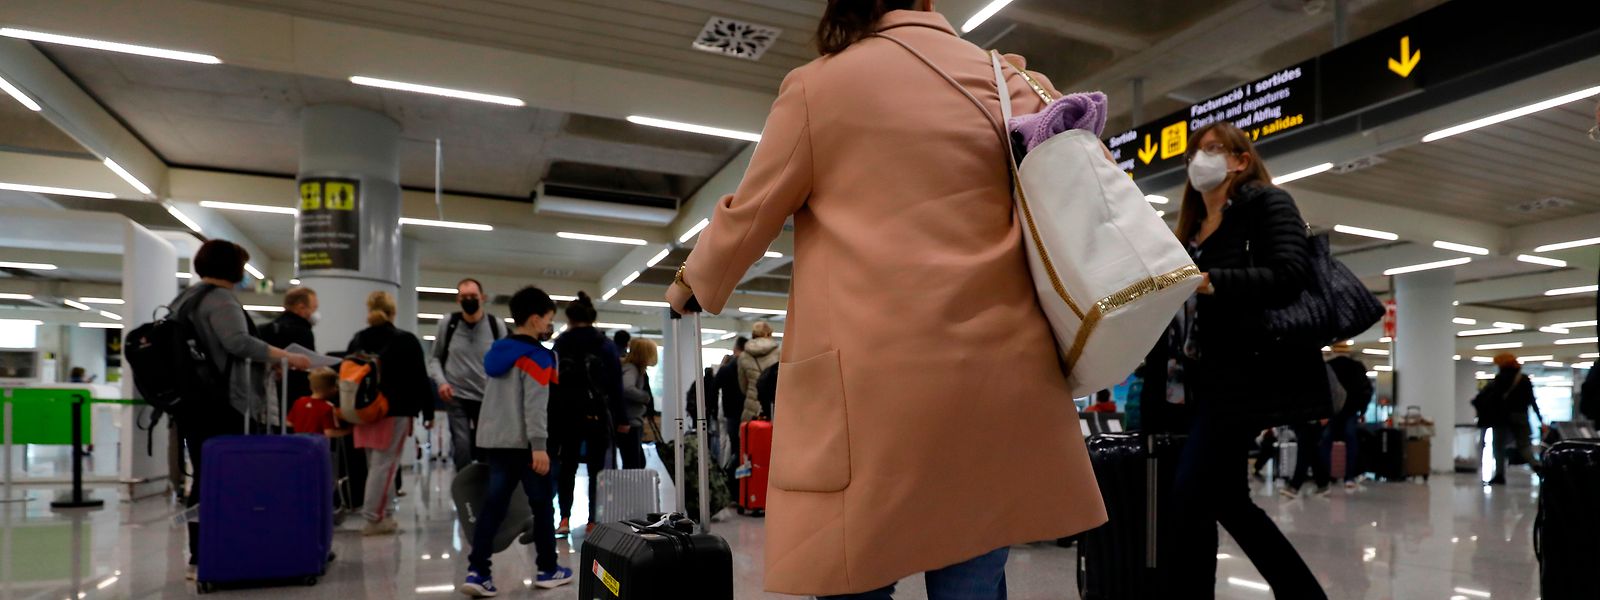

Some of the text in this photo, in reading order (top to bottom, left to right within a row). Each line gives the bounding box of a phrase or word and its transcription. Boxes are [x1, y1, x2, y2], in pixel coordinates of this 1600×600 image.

[1190, 87, 1244, 118] Facturació
[1255, 67, 1302, 93] sortides
[1225, 102, 1242, 119] and
[1243, 87, 1290, 112] departures
[1235, 105, 1282, 129] und Abflug
[1252, 128, 1260, 141] y
[1262, 113, 1304, 136] salidas
[1109, 130, 1137, 149] Sortida
